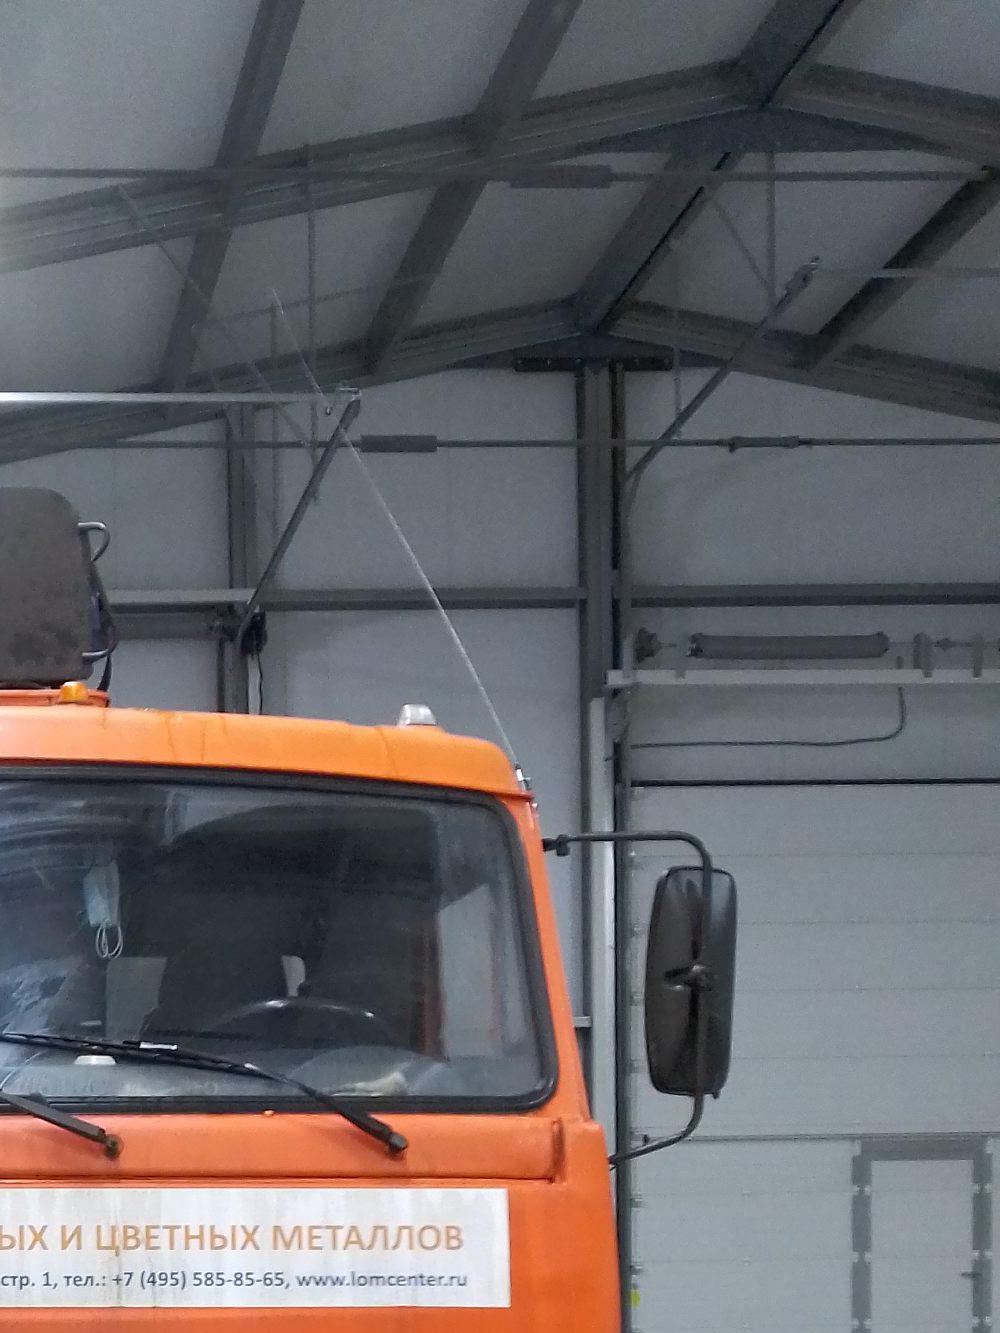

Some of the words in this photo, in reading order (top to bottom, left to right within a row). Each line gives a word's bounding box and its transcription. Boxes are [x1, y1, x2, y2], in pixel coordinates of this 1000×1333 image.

[60, 1224, 84, 1251] И
[95, 1224, 262, 1257] ЦВЕТНЫХ
[271, 1224, 465, 1252] МЕТАЛЛОВ
[0, 1275, 36, 1293] стр.
[42, 1271, 59, 1290] 1,
[62, 1275, 107, 1288] тел.:
[111, 1271, 135, 1288] +7
[140, 1270, 187, 1291] (495)
[192, 1271, 291, 1290] 585-85-65,
[295, 1270, 468, 1288] www.lomcenter.ru
